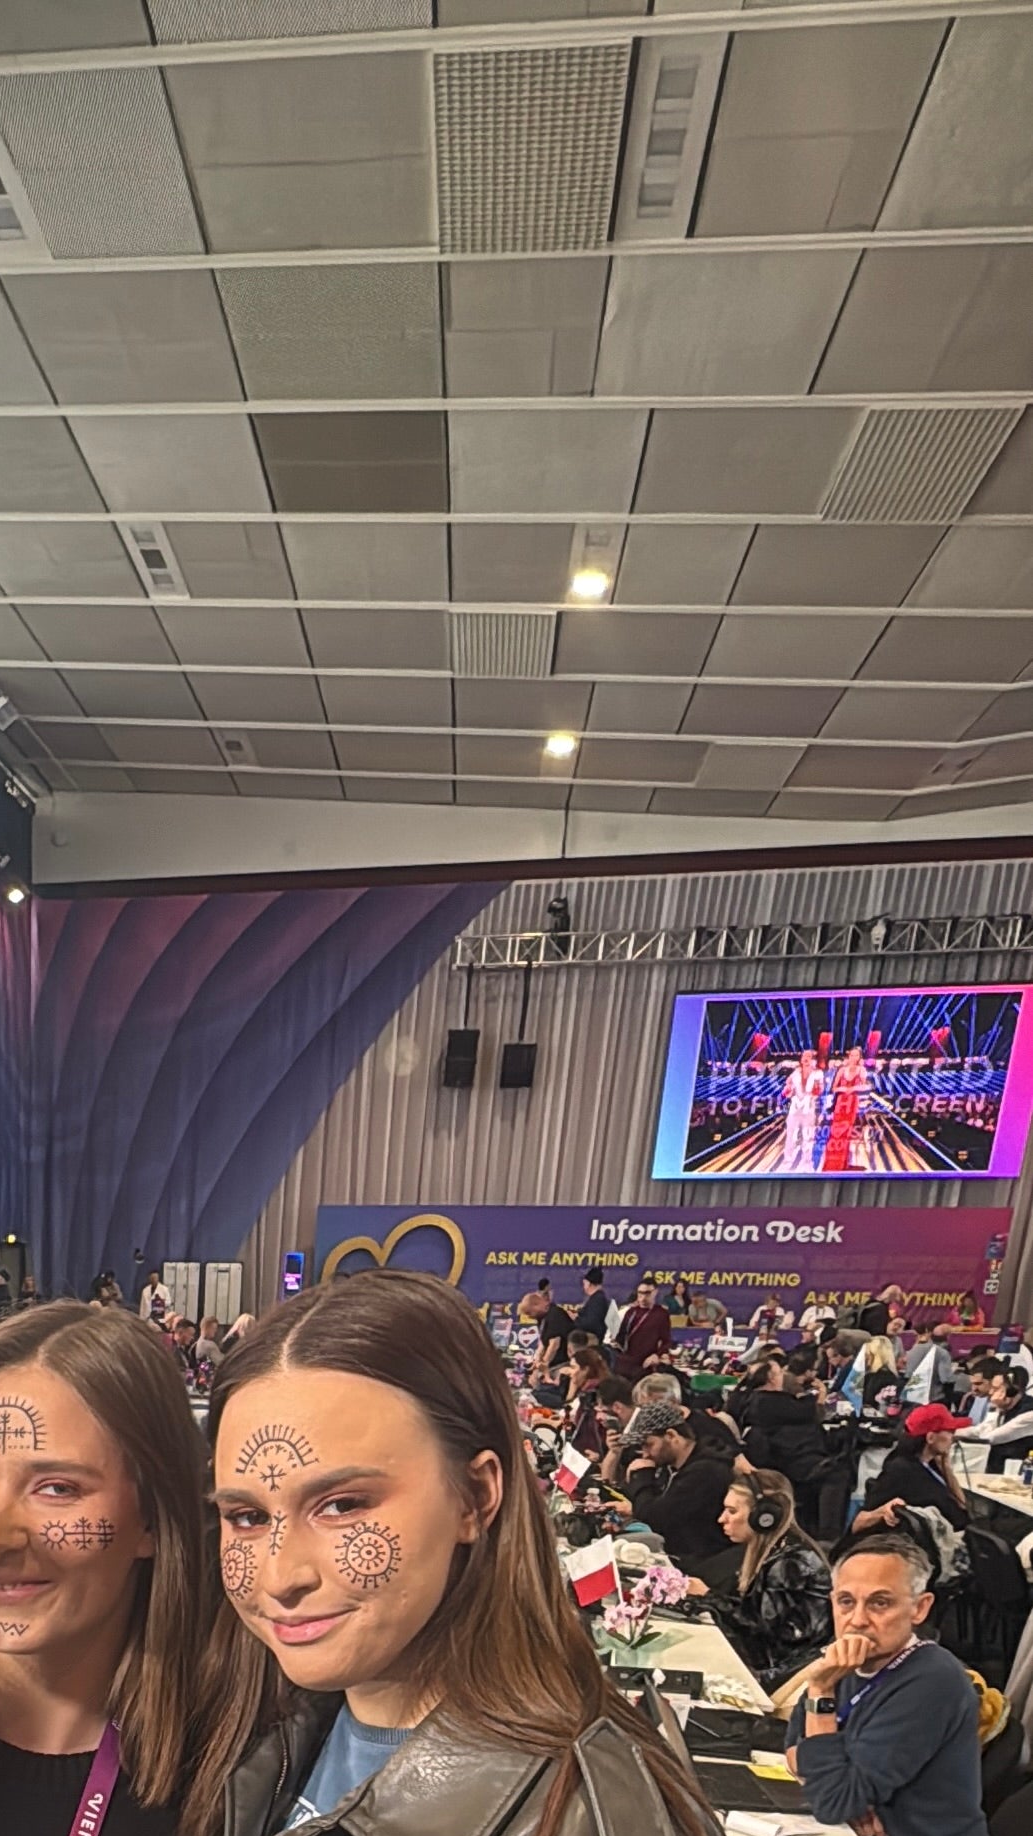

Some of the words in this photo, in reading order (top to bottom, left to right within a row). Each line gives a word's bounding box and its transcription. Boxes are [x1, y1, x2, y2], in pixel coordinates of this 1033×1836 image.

[878, 1093, 987, 1115] CREEN
[590, 1218, 759, 1245] Information
[765, 1220, 845, 1244] Desk
[486, 1251, 519, 1266] ASK
[522, 1252, 548, 1266] ME
[549, 1252, 639, 1267] ANYTHING
[643, 1271, 677, 1285] ASK
[680, 1271, 706, 1285] ME
[708, 1272, 801, 1287] ANYTHING
[803, 1291, 841, 1305] AK
